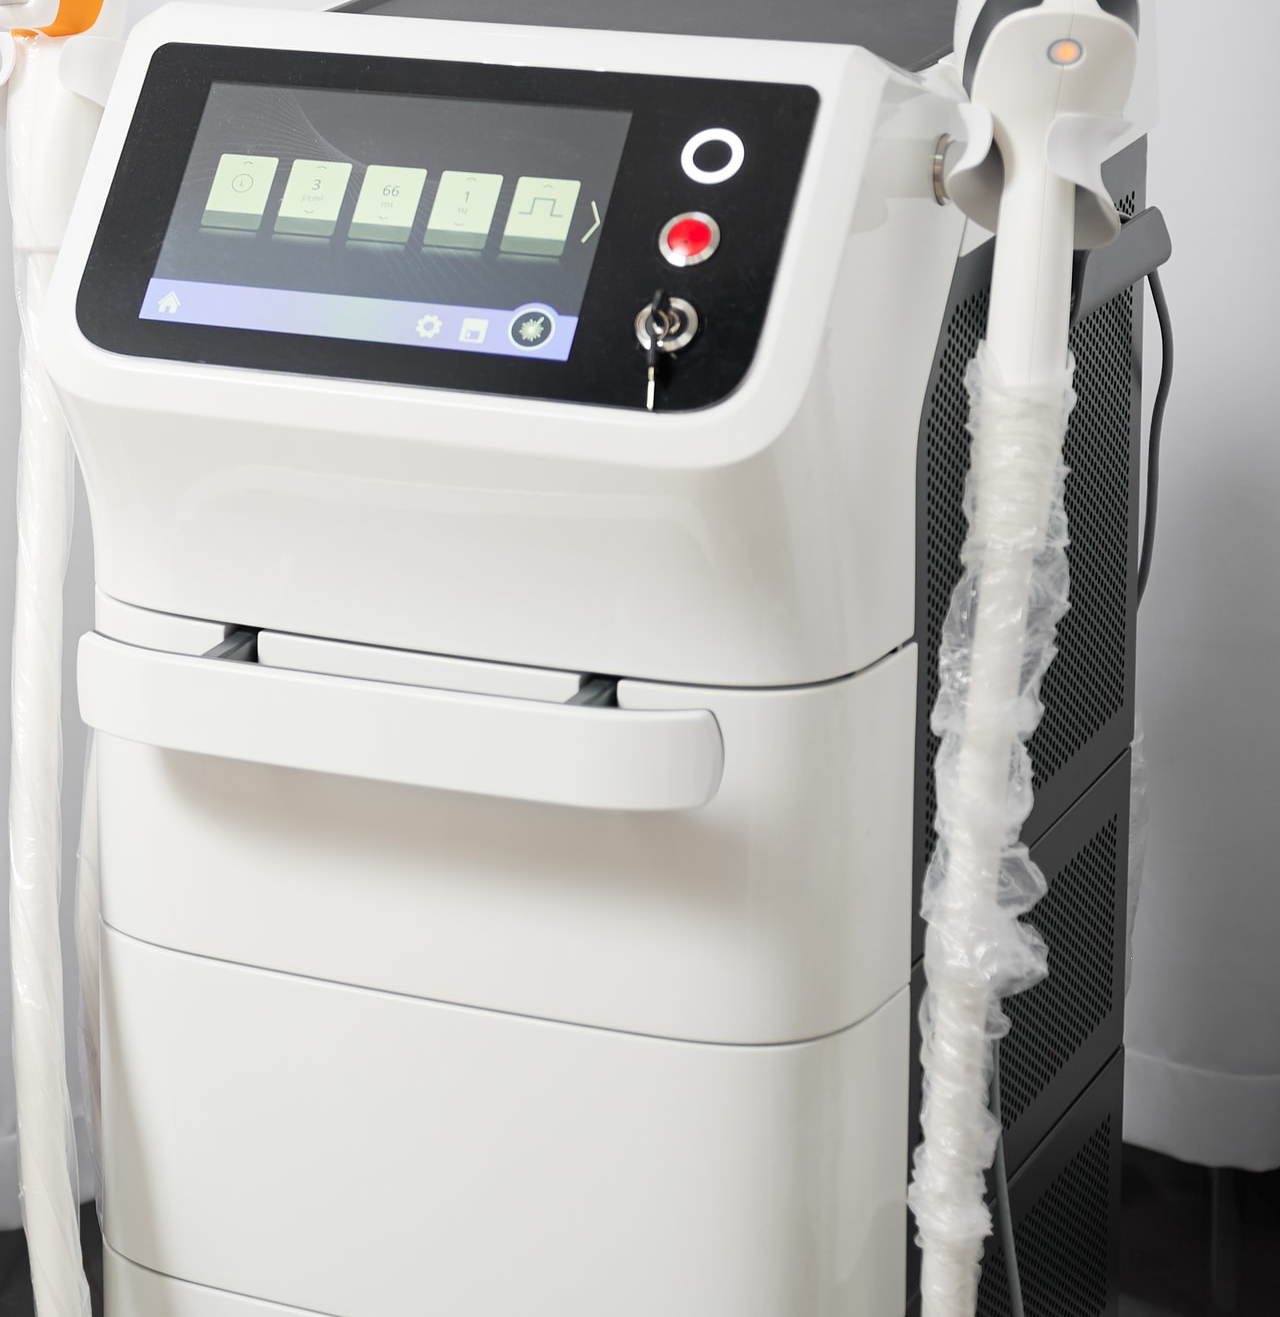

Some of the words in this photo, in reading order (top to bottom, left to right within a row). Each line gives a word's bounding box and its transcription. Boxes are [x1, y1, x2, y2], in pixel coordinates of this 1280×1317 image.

[312, 179, 321, 191] 3
[383, 185, 400, 197] 66
[464, 191, 470, 203] 1
